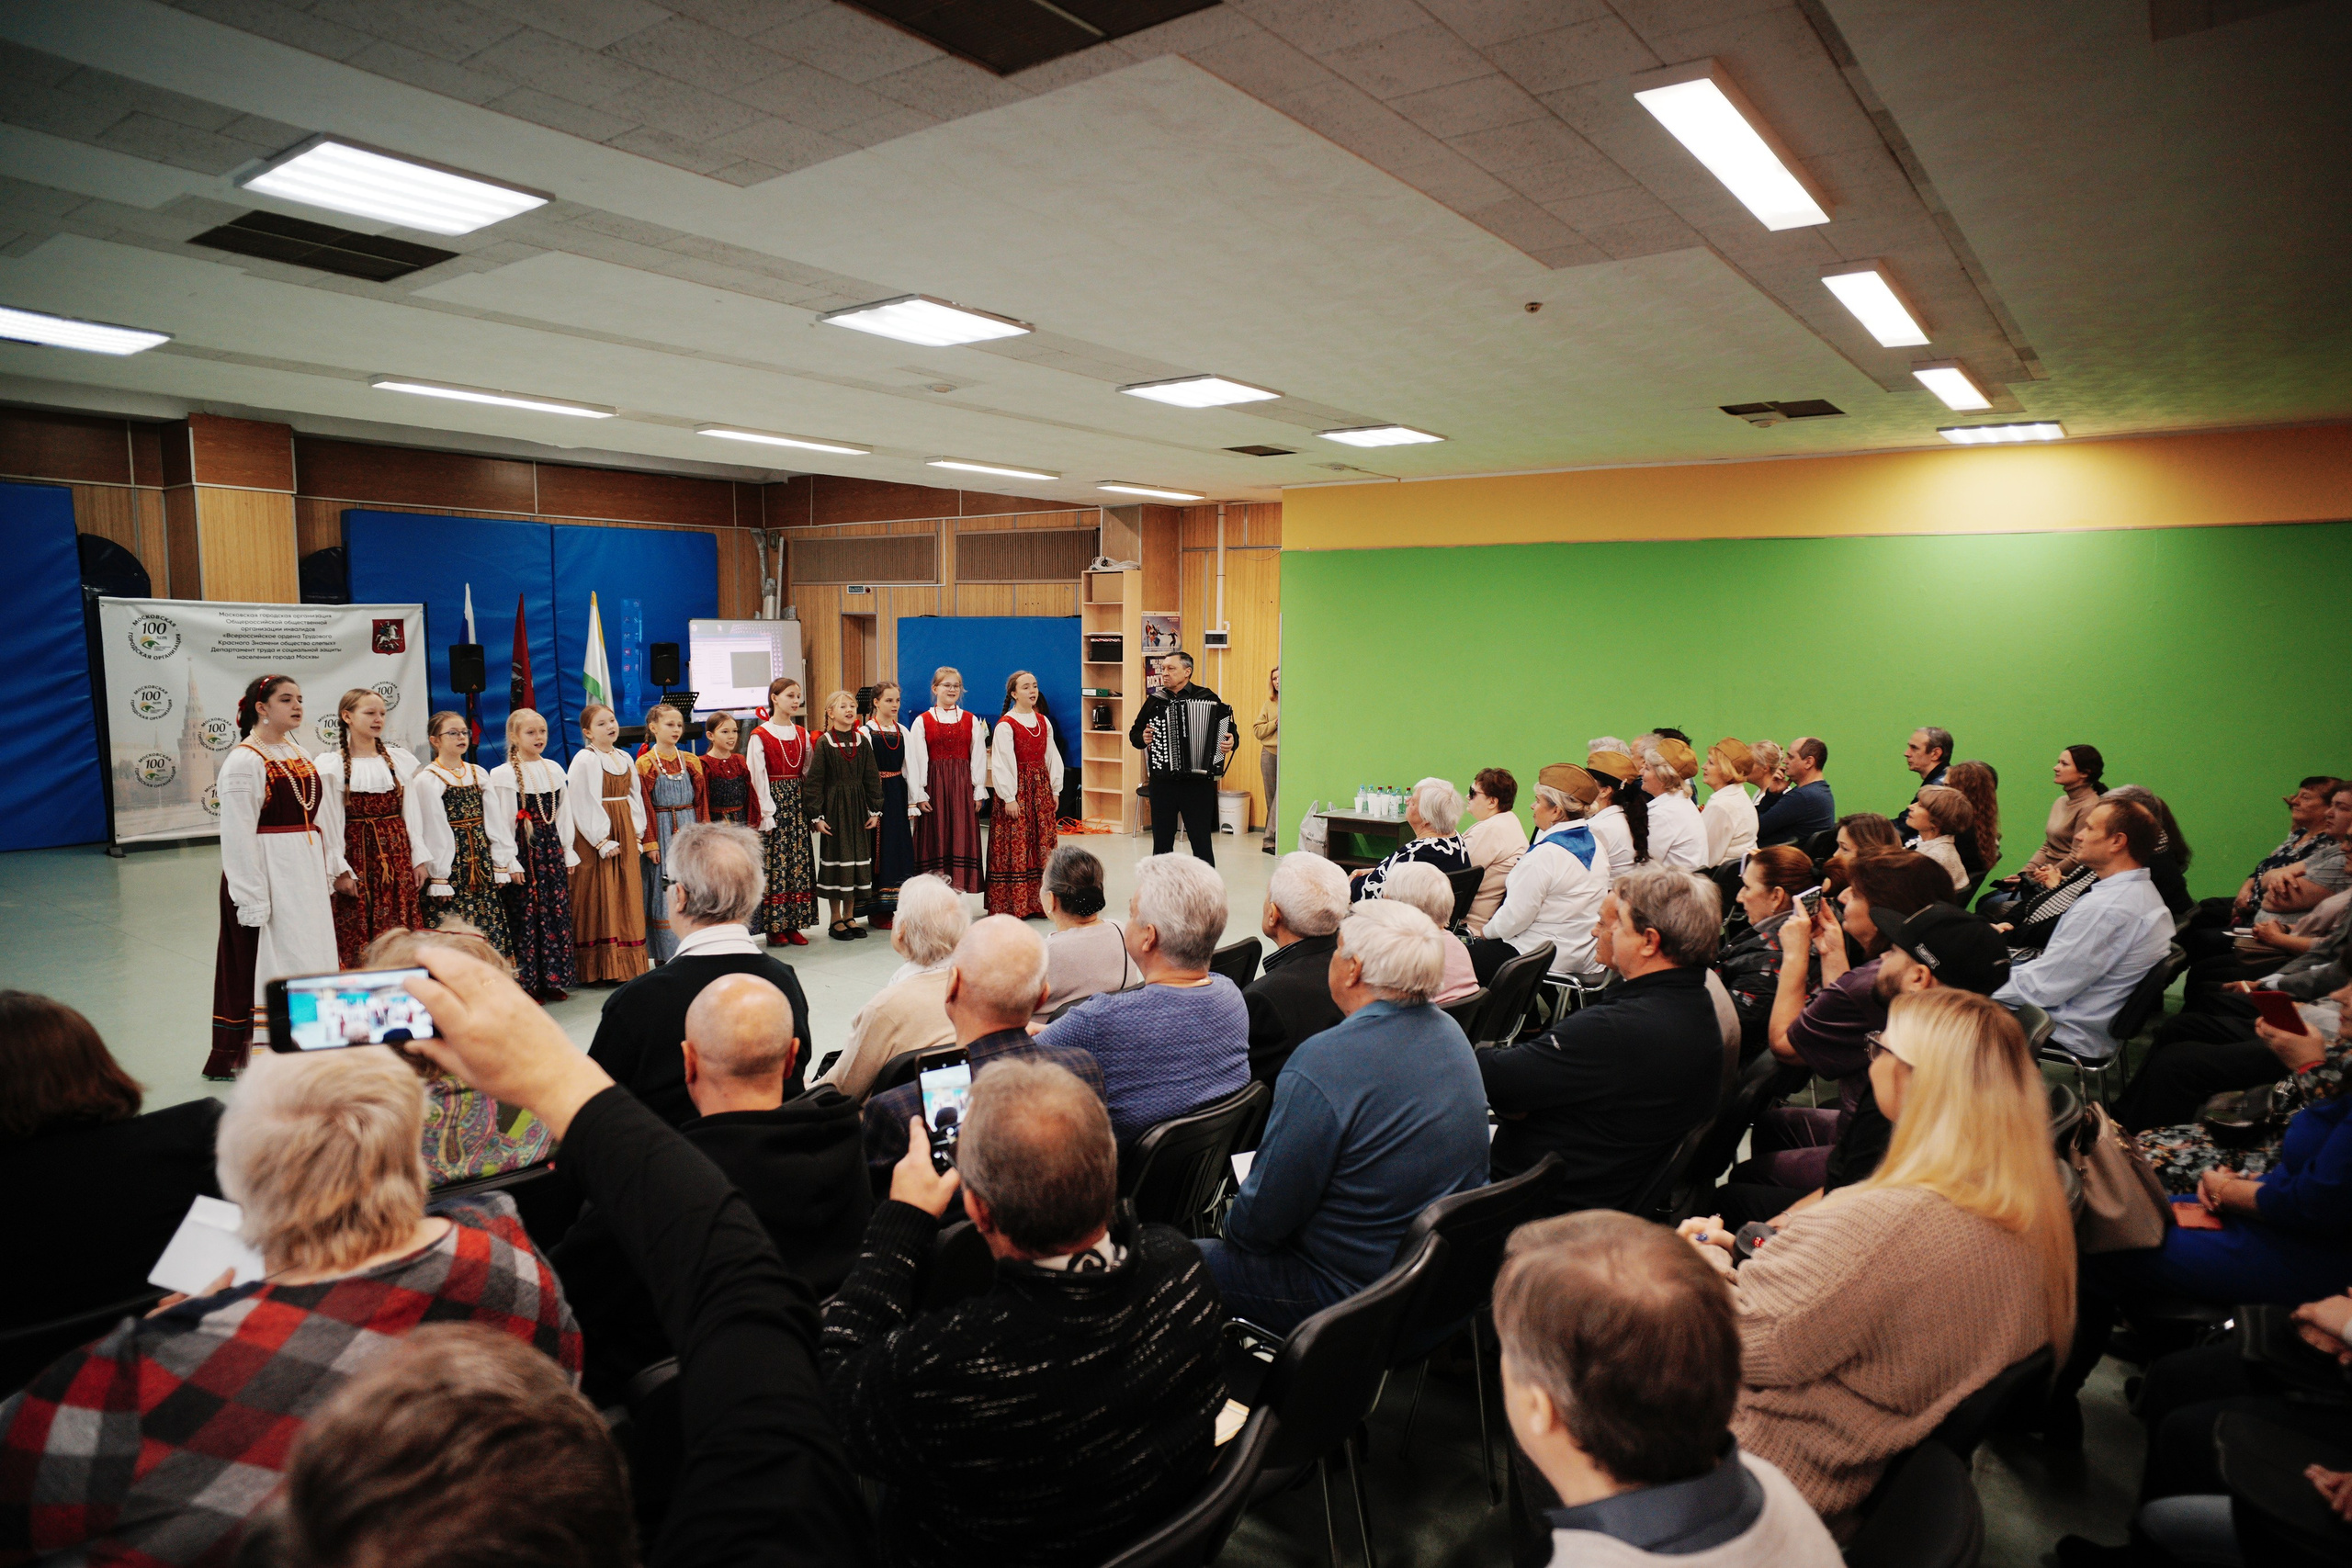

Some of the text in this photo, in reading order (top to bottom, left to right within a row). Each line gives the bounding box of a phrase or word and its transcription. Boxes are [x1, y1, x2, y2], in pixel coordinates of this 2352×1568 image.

[132, 615, 176, 627] МОСКОВСКАЯ
[142, 622, 167, 635] 100
[222, 632, 277, 640] «Всероссийское
[128, 632, 182, 660] ГОРОДСКАЯ ОРГАНИЗАЦИЯ
[133, 684, 168, 695] МОСКОВСКАЯ
[378, 686, 393, 695] 100
[141, 691, 161, 701] 100
[130, 699, 173, 720] ГОРОДСКАЯ ОРГАНИЗАЦИЯ
[201, 717, 232, 728] МОСКОВСКАЯ
[208, 723, 226, 733] 100
[138, 752, 172, 763] МОСКОВСКАЯ
[145, 758, 165, 769] 100
